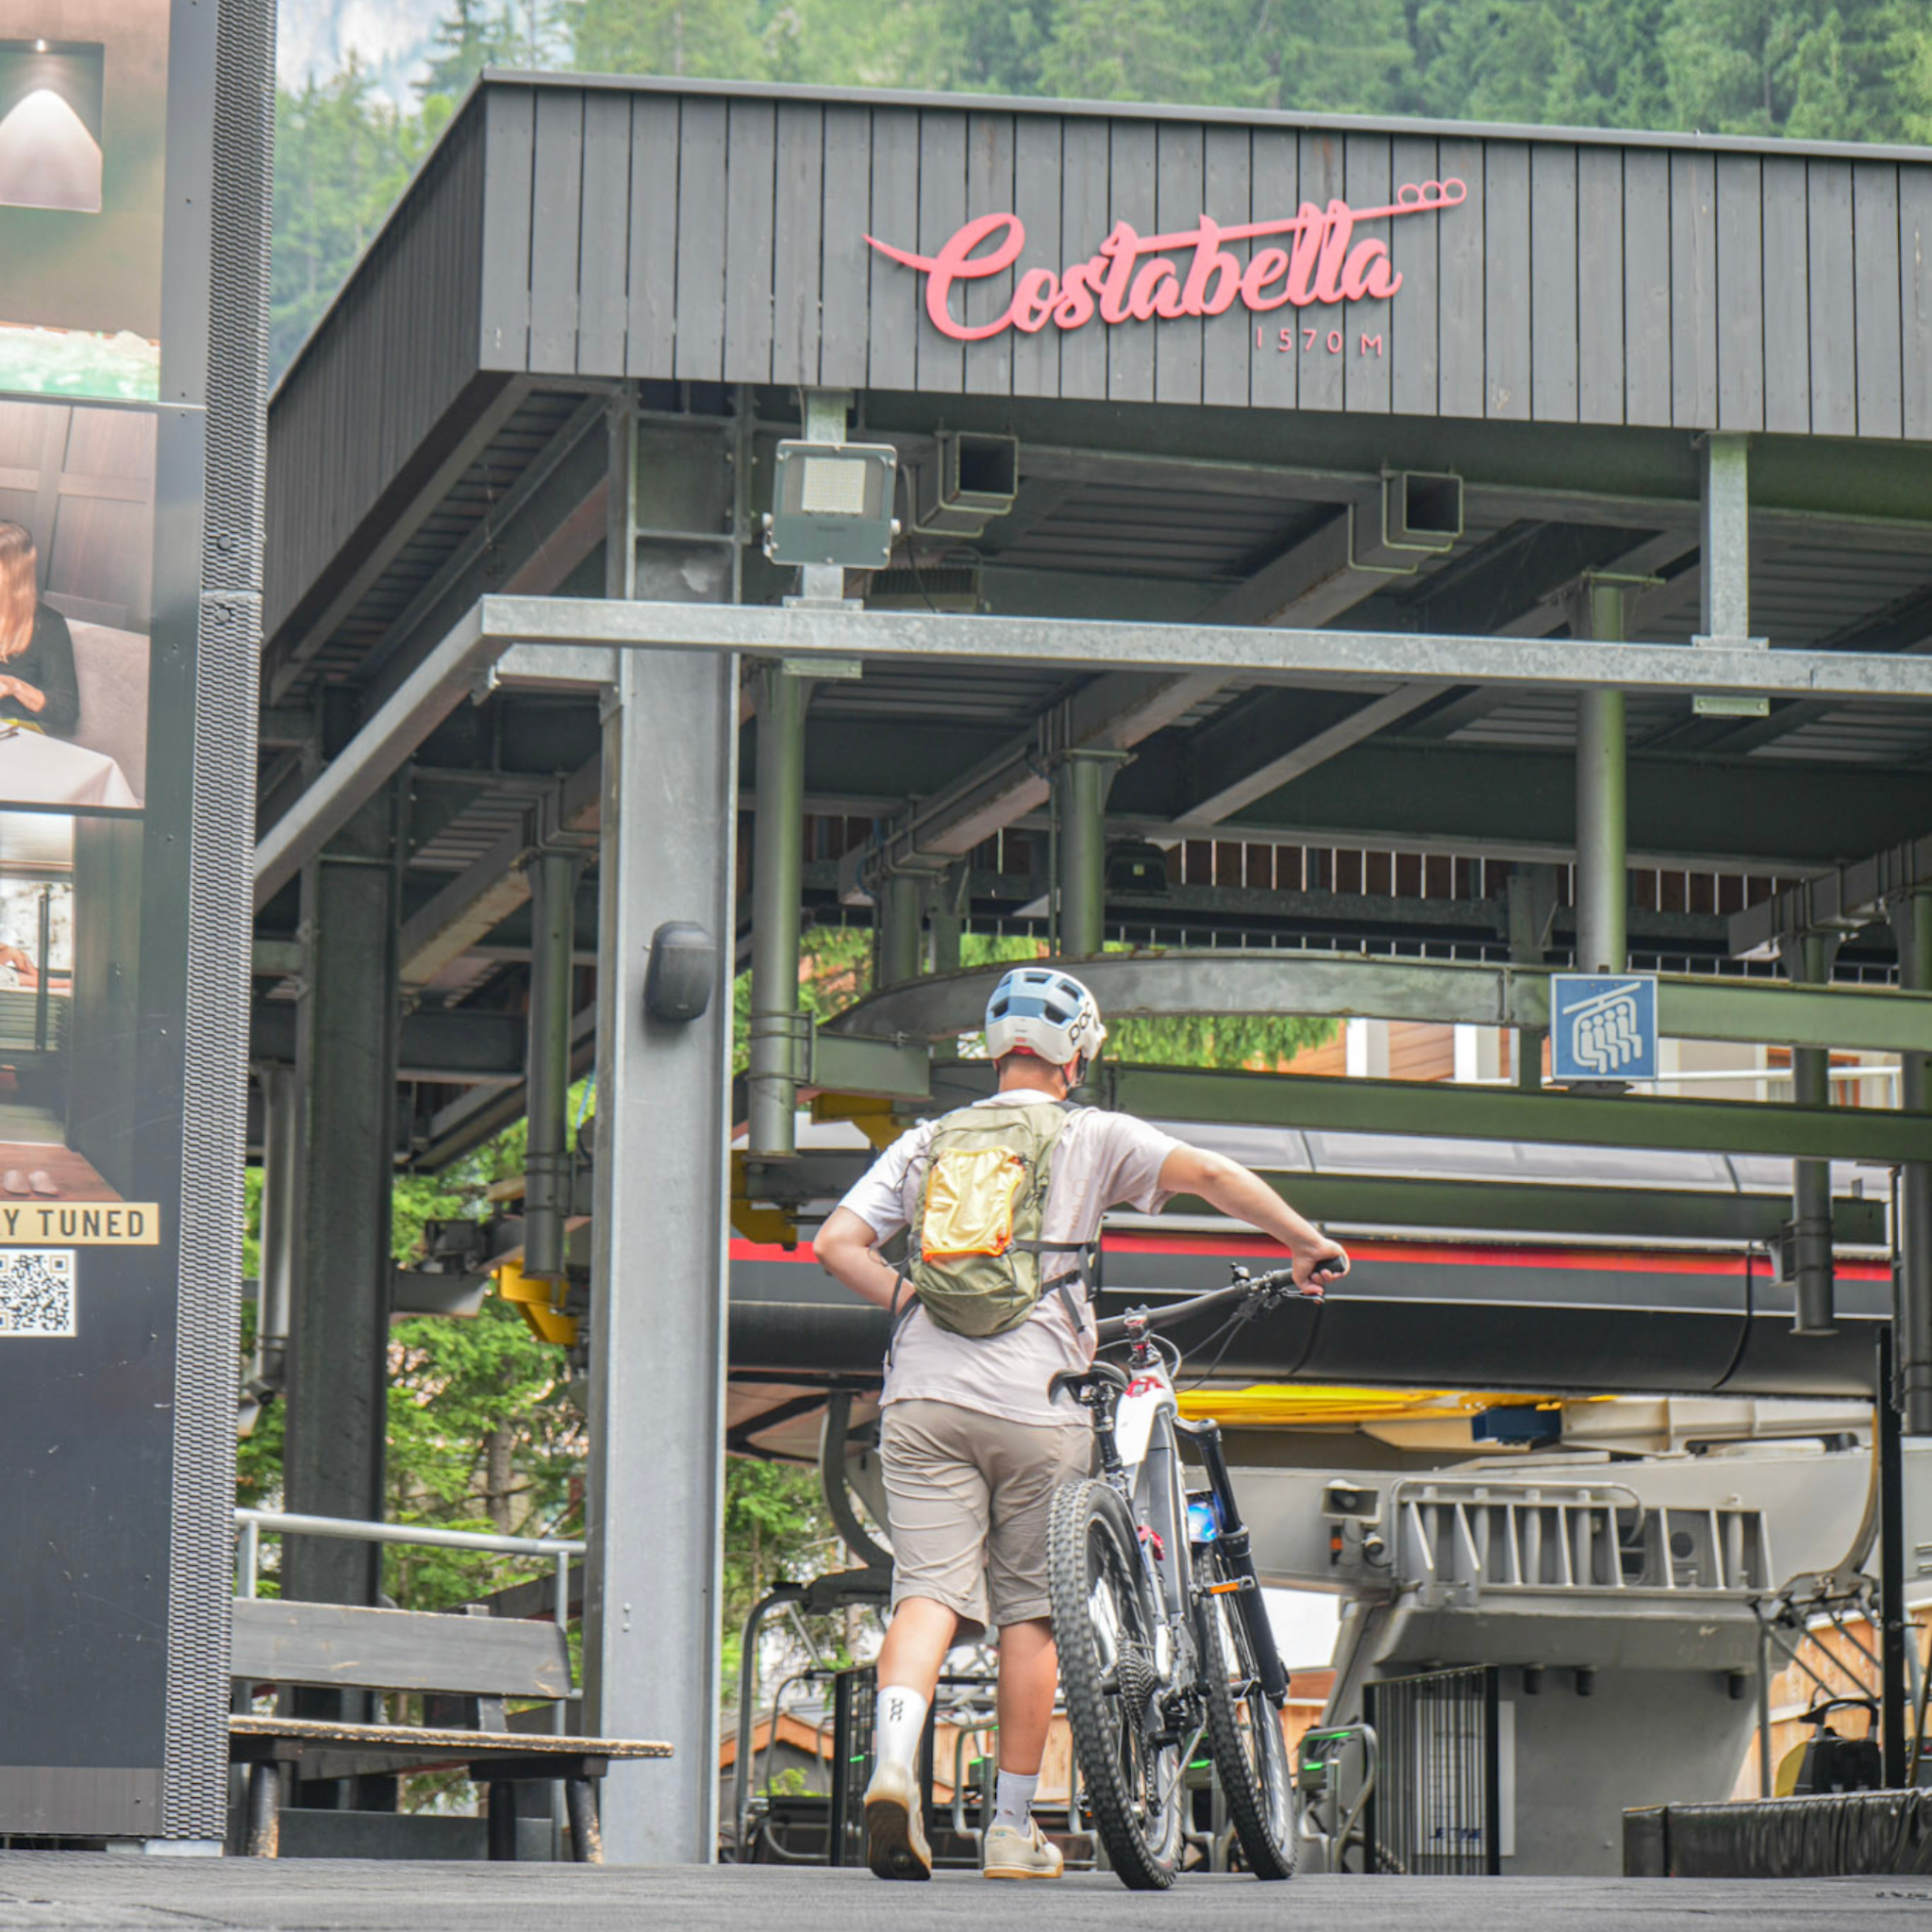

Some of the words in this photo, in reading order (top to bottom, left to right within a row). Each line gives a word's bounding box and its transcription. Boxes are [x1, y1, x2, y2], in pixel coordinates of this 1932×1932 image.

[862, 199, 1403, 340] Costabella
[1256, 326, 1342, 354] 1570
[1360, 333, 1382, 357] M
[0, 1208, 20, 1236] Y
[37, 1209, 144, 1237] TUNED
